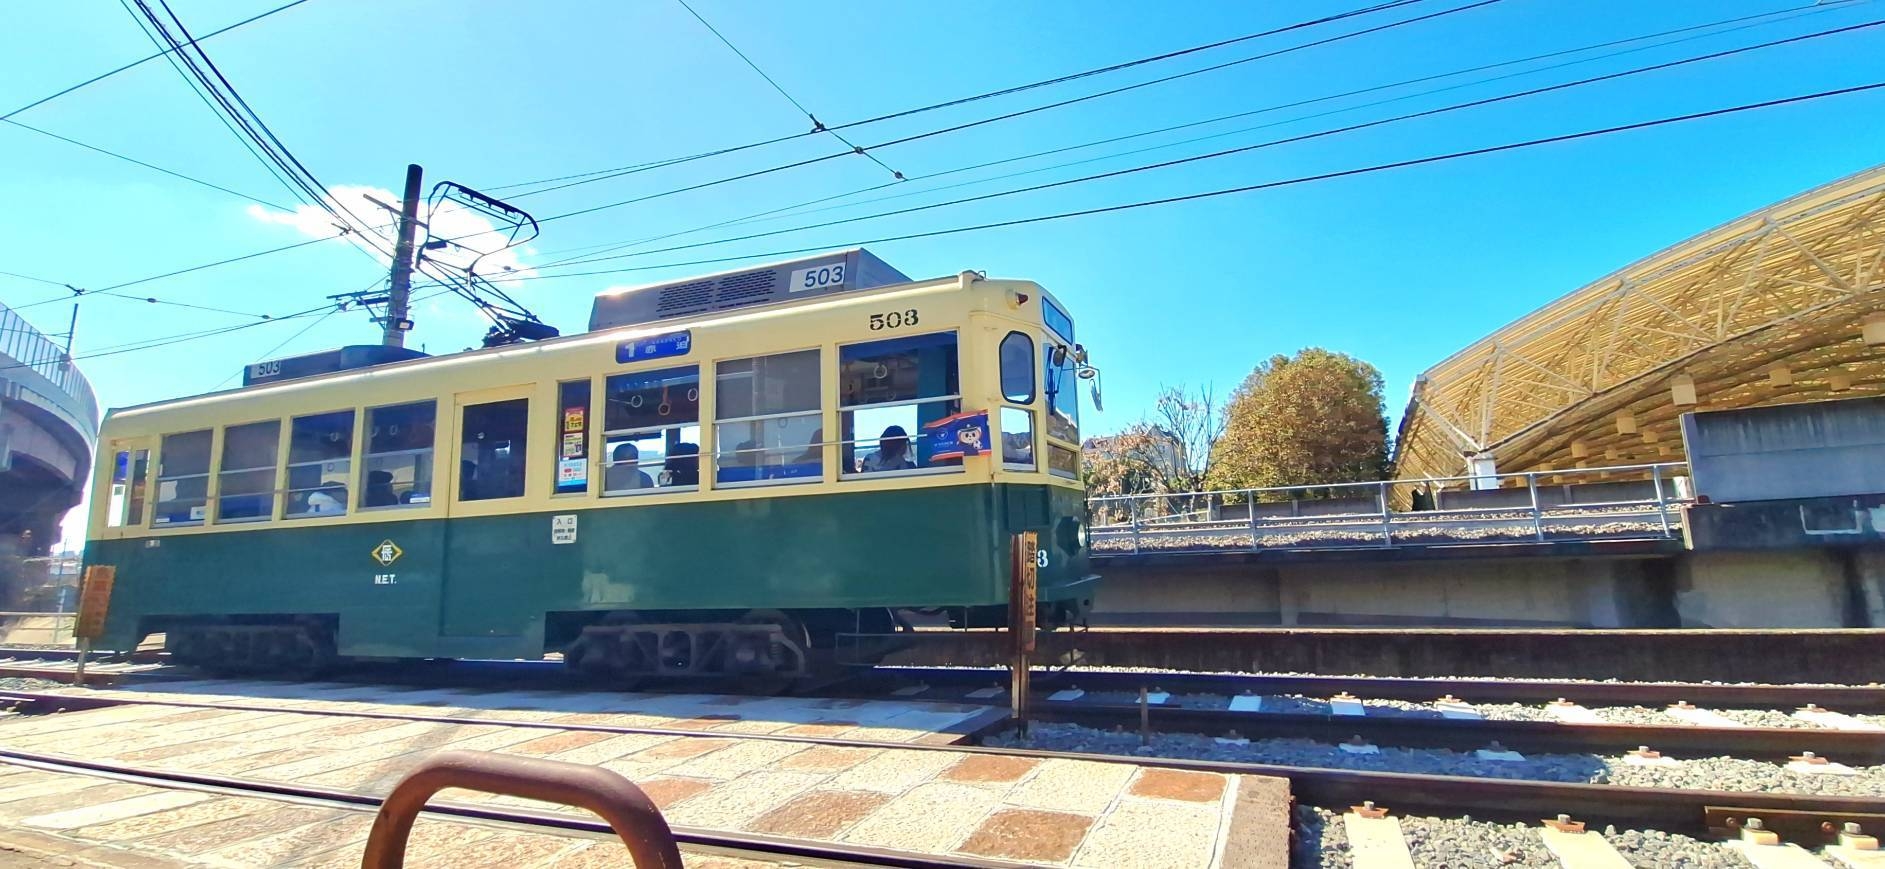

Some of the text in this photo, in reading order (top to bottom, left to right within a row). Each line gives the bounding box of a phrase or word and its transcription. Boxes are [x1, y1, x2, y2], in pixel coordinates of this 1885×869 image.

[803, 266, 844, 288] 503
[869, 309, 919, 331] 503
[259, 361, 280, 375] 503
